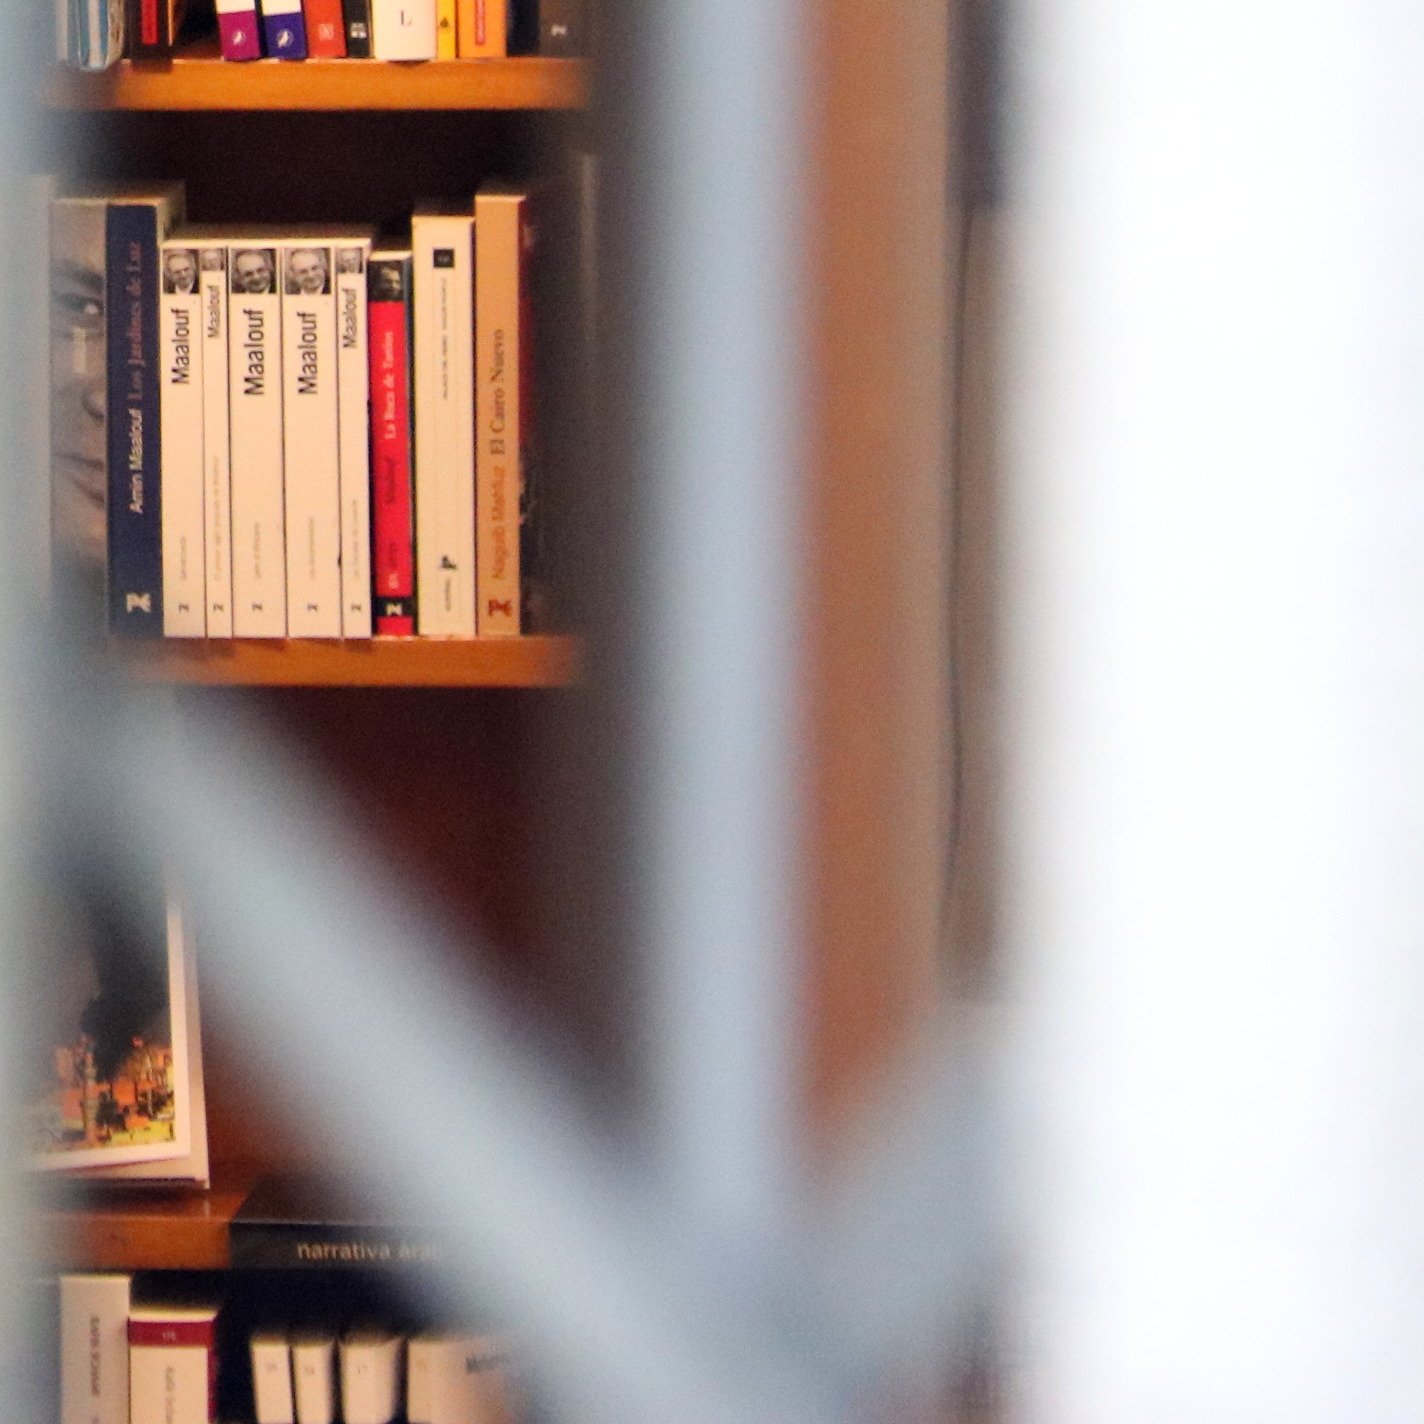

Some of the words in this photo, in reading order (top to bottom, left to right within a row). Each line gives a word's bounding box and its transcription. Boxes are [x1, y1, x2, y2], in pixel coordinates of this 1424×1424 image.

[125, 241, 142, 273] Luz
[126, 275, 142, 297] de
[207, 284, 222, 340] Maalouf
[127, 301, 145, 368] Jardines
[343, 287, 358, 349] Maalouf
[171, 307, 191, 386] Maalouf
[244, 308, 265, 397] Maalouf
[298, 311, 319, 396] Maalouf
[489, 328, 505, 383] Nuevo
[127, 371, 143, 401] Los
[490, 387, 506, 435] Cairo
[127, 408, 144, 471] Maalouf
[490, 439, 506, 456] El
[128, 475, 144, 515] Amin
[491, 526, 508, 581] Naguib
[297, 1242, 391, 1260] narrativa
